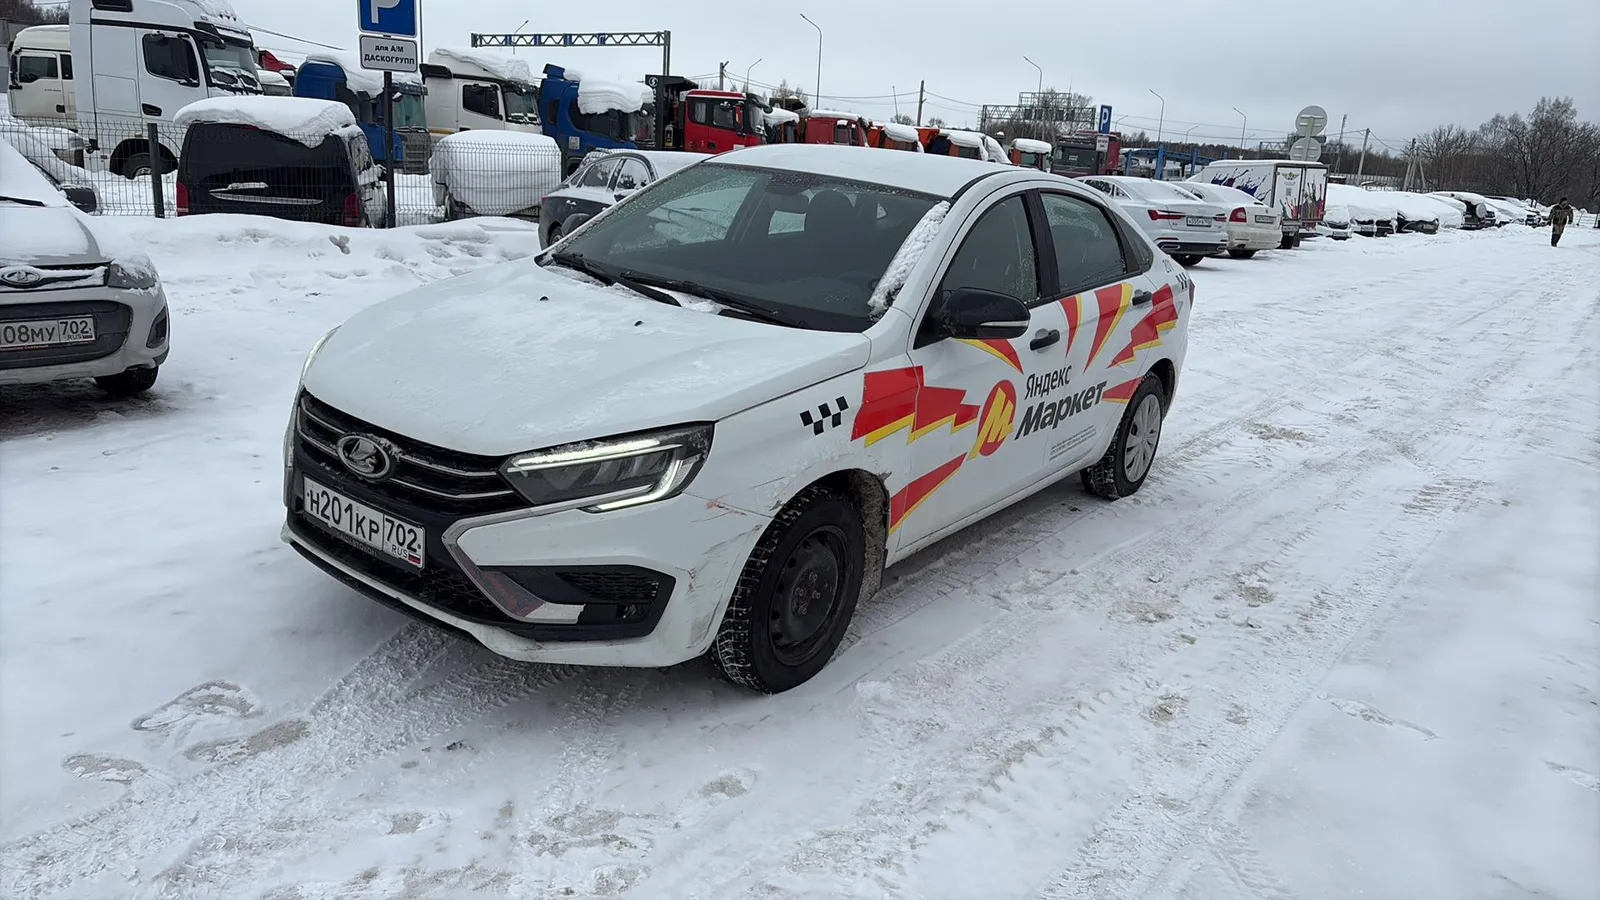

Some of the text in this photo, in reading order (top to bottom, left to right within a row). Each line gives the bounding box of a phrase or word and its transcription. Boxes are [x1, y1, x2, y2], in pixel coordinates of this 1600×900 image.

[364, 54, 415, 65] ДАСКОГРУПП
[1101, 107, 1109, 131] P
[0, 320, 88, 344] 08МУ 702
[1024, 365, 1072, 400] Яндекс
[1014, 381, 1107, 441] Маркет
[385, 517, 418, 553] 702
[391, 544, 408, 559] RUS
